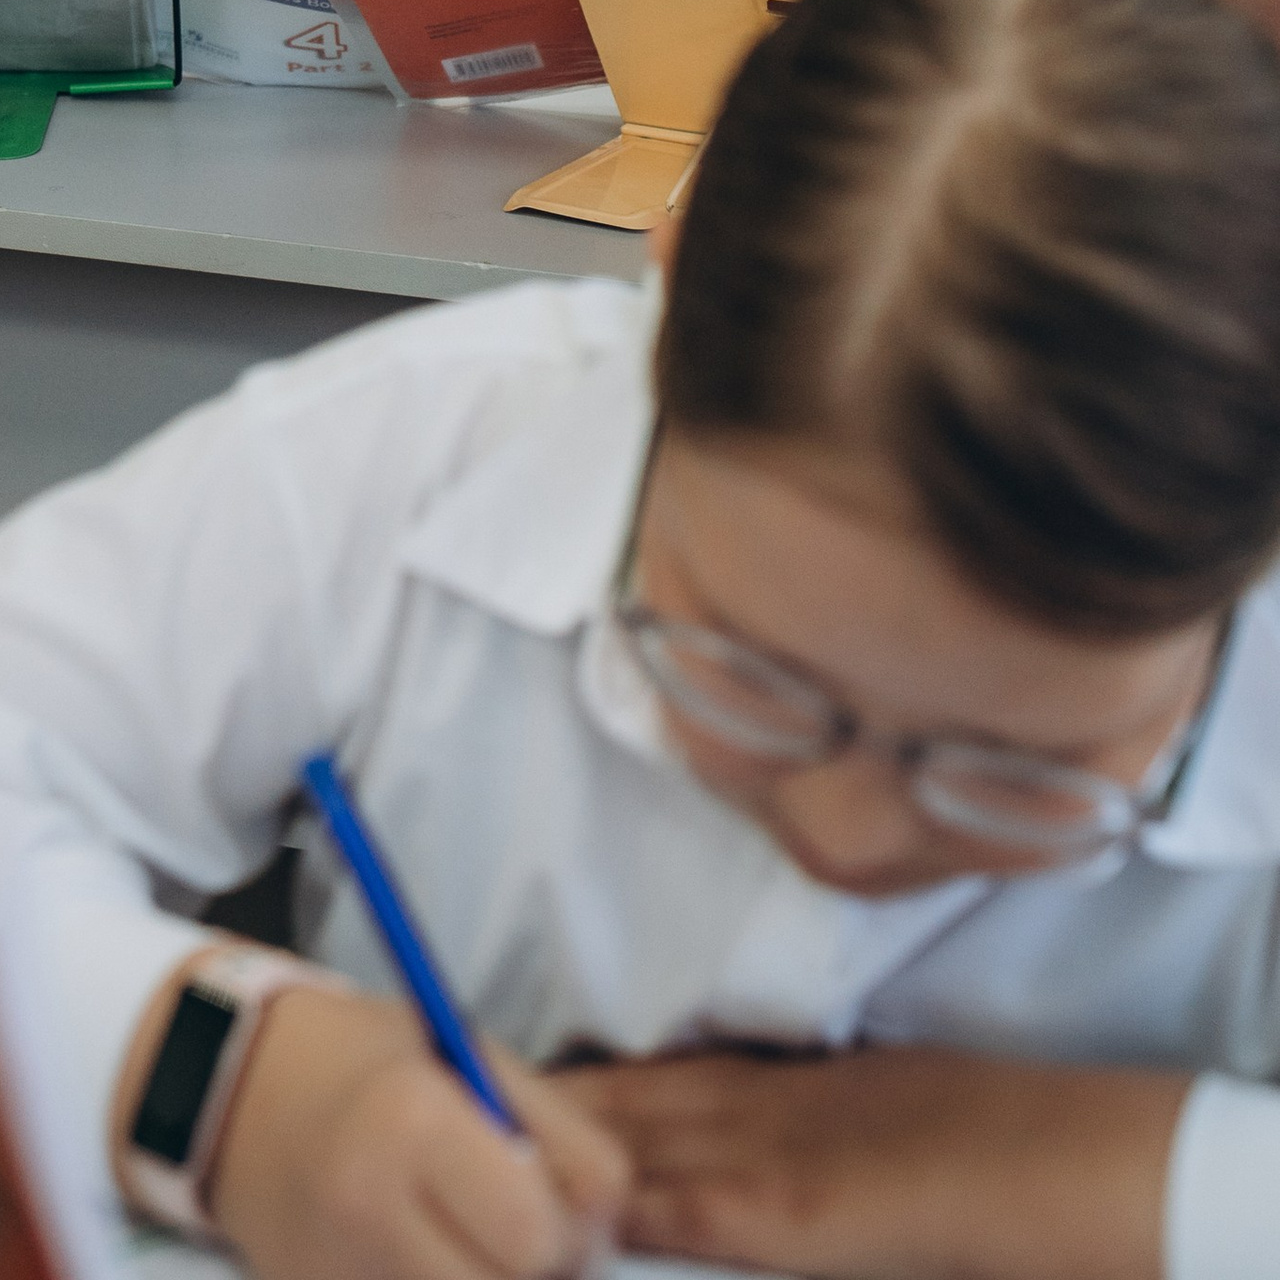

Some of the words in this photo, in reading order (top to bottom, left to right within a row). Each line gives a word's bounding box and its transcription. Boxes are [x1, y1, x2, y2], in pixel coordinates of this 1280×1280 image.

[283, 20, 348, 61] 4
[287, 61, 344, 74] Part
[359, 60, 375, 74] 2
